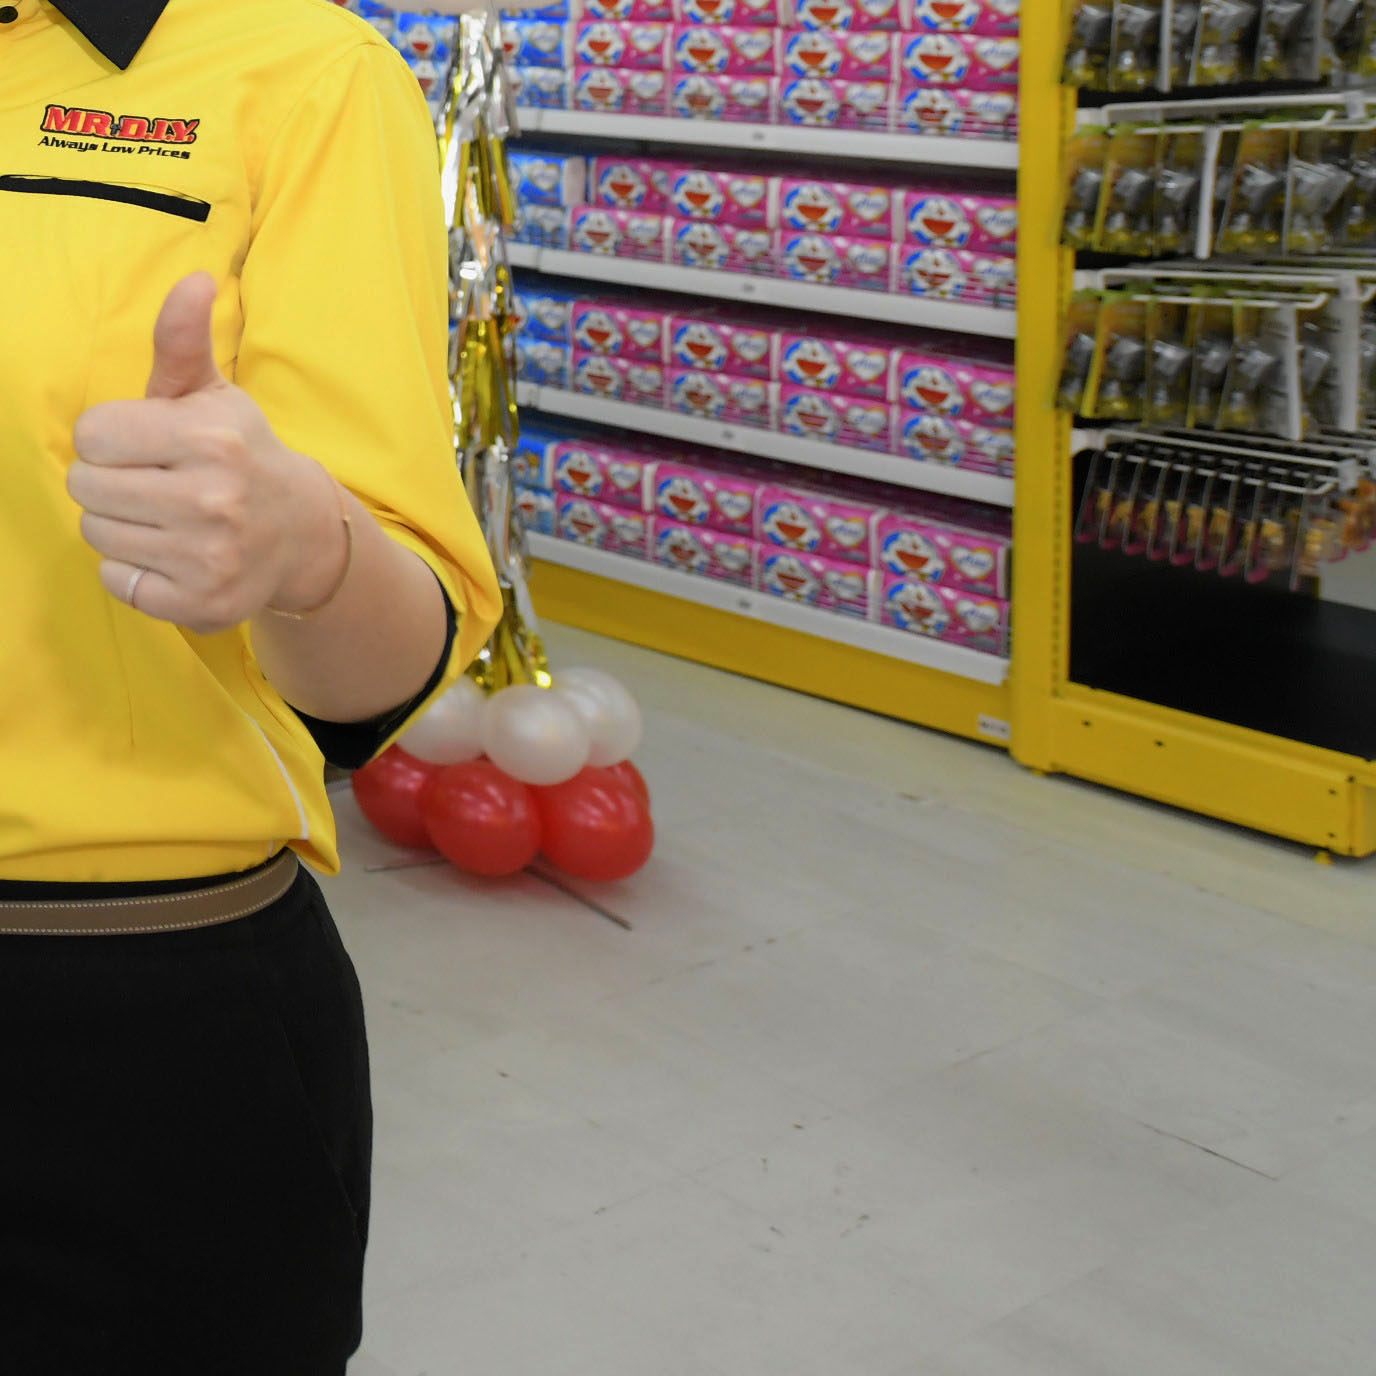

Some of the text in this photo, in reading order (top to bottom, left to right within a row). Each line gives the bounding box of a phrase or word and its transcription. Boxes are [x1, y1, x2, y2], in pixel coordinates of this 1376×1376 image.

[38, 136, 191, 160] Always Low Prices
